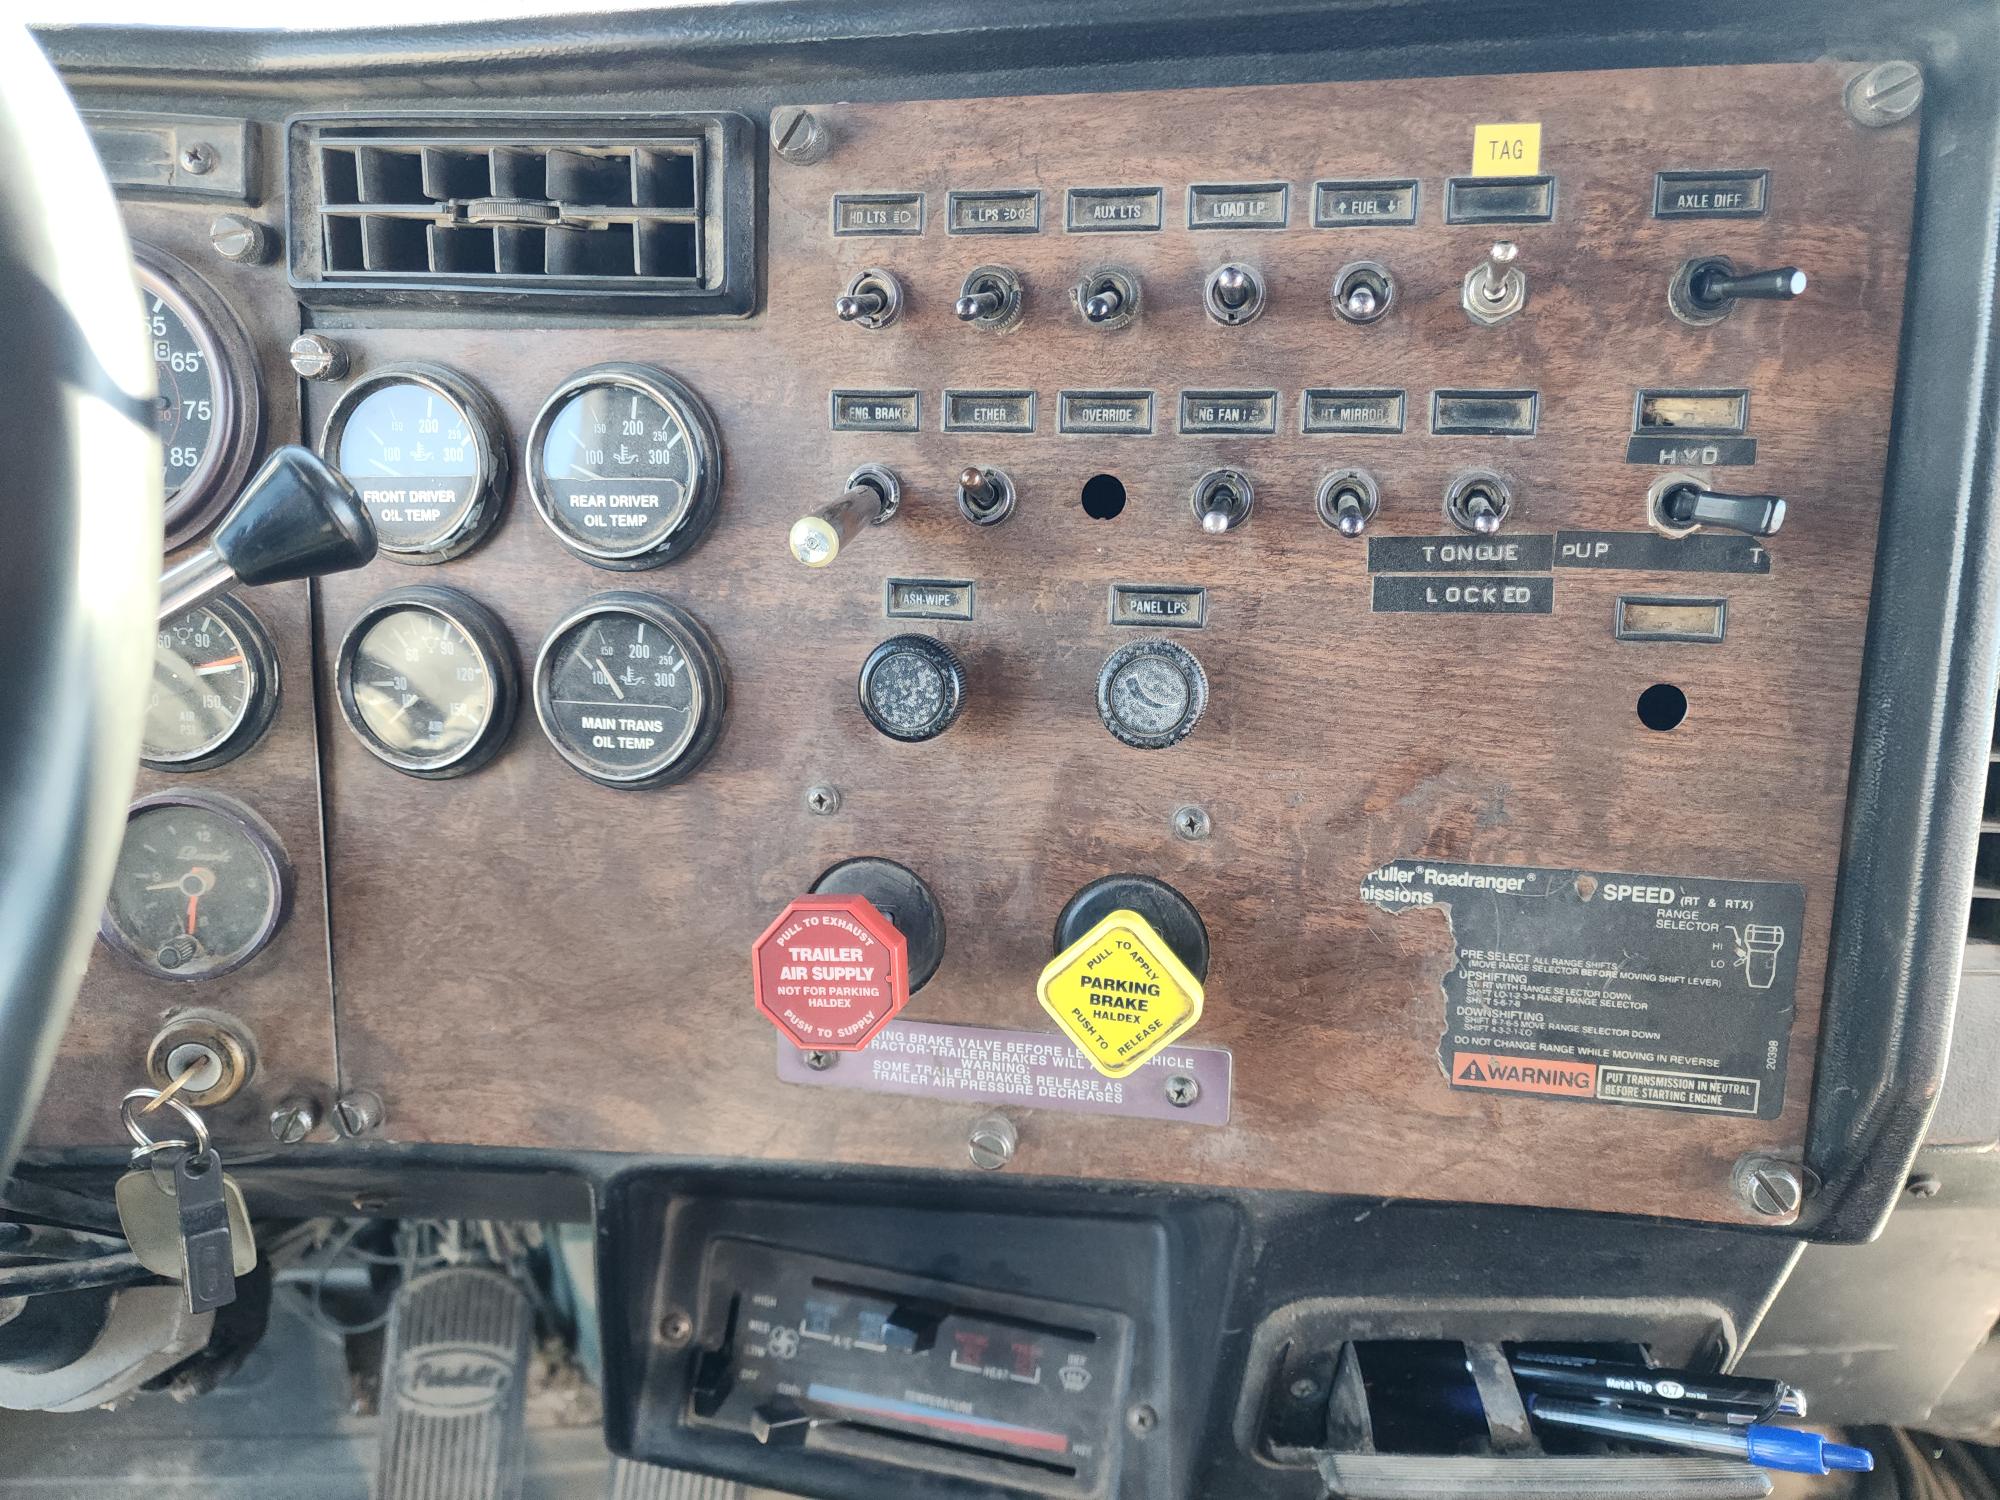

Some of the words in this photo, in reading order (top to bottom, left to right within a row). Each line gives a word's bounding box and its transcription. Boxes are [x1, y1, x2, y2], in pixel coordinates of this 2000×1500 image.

[1489, 140, 1523, 160] TAG
[1351, 201, 1381, 214] FUEL
[1677, 194, 1710, 209] AXLE
[1713, 193, 1743, 208] DIFF
[867, 211, 886, 224] LTS
[978, 208, 999, 222] LPS
[1093, 206, 1116, 220] AUX
[1120, 205, 1141, 219] LTS
[1213, 203, 1245, 218] LOAD
[1249, 202, 1266, 216] LP
[171, 353, 198, 373] 65
[183, 401, 211, 420] 75
[875, 407, 908, 421] BRAKE
[974, 409, 1007, 421] ETHER
[1082, 408, 1132, 422] OVERRIDE
[1218, 408, 1239, 421] FAN
[1340, 408, 1384, 421] MIRROR
[418, 419, 438, 433] 200
[594, 424, 606, 434] 150
[622, 420, 643, 436] 200
[653, 432, 667, 443] 250
[170, 447, 197, 467] 85
[384, 447, 401, 461] 100
[443, 447, 464, 462] 300
[586, 450, 604, 465] 100
[648, 450, 670, 465] 300
[363, 491, 406, 503] FRONT
[409, 491, 456, 503] DRIVER
[570, 494, 607, 507] REAR
[609, 494, 659, 508] DRIVER
[381, 509, 401, 522] OIL
[404, 509, 441, 522] TEMP
[584, 514, 608, 527] OIL
[611, 514, 648, 527] TEMP
[1422, 545, 1519, 562] TONGUE
[1562, 543, 1611, 558] PUP
[1749, 547, 1764, 563] T
[1426, 586, 1531, 603] LOCKED
[1129, 599, 1162, 614] PANEL
[1166, 602, 1188, 614] LPS
[194, 633, 210, 648] 90
[441, 641, 455, 656] 90
[600, 646, 613, 656] 150
[630, 644, 650, 660] 200
[660, 655, 674, 666] 250
[456, 667, 475, 682] 120
[592, 672, 610, 685] 100
[654, 672, 676, 688] 300
[394, 676, 407, 690] 30
[203, 695, 221, 709] 150
[581, 717, 617, 731] MAIN
[618, 719, 664, 733] TRANS
[592, 735, 616, 748] OIL
[618, 737, 655, 750] TEMP
[1603, 883, 1676, 905] SPEED
[1680, 895, 1701, 908] (RT
[1707, 896, 1717, 908] &
[1725, 899, 1754, 912] RTX)
[1656, 909, 1700, 921] RANGE
[777, 924, 804, 947] PULL
[803, 916, 820, 929] TO
[822, 916, 874, 946] EXHAUST
[1655, 919, 1720, 932] SELECTOR
[1712, 942, 1723, 951] HI
[788, 948, 864, 963] TRAILER
[1086, 949, 1113, 970] PULL
[1115, 940, 1132, 951] TO
[1129, 951, 1160, 981] APPLY
[1461, 950, 1531, 964] PRE-SELECT
[1533, 957, 1549, 966] ALL
[1551, 958, 1584, 968] RANGE
[1585, 961, 1618, 971] SHIFTS
[1711, 960, 1725, 969] LO
[780, 966, 809, 980] AIR
[812, 966, 875, 982] SUPPLY
[1459, 971, 1528, 984] UPSHIFTING
[1499, 961, 1530, 972] RANGE
[1532, 964, 1579, 976] SELECTOR
[1581, 968, 1619, 979] BEFORE
[1620, 971, 1657, 982] MOVING
[1659, 974, 1686, 984] SHIFT
[1687, 977, 1722, 988] LEVER)
[777, 986, 801, 996] NOT
[803, 986, 826, 997] FOR
[828, 987, 880, 997] PARKING
[1080, 975, 1161, 998] PARKING
[1495, 983, 1519, 992] WITH
[1520, 985, 1552, 994] RANGE
[1553, 987, 1601, 998] SELECTOR
[1602, 991, 1631, 1001] DOWN
[808, 998, 852, 1008] HALDEX
[1089, 993, 1149, 1012] BRAKE
[1537, 994, 1566, 1004] RAISE
[1568, 996, 1599, 1006] RANGE
[1600, 999, 1649, 1010] SELECTOR
[1093, 1010, 1142, 1025] HALDEX
[1456, 1006, 1545, 1022] DOWNSHIFTING
[784, 1010, 814, 1034] PUSH
[818, 1028, 833, 1038] TO
[838, 1010, 876, 1038] SUPPLY
[1071, 1007, 1097, 1036] PUSH
[1095, 1031, 1109, 1051] TO
[1117, 1018, 1164, 1056] RELEASE
[1464, 1015, 1490, 1025] SHIFT
[1521, 1020, 1546, 1030] MOVE
[1549, 1022, 1581, 1033] RANGE
[1582, 1025, 1630, 1037] SELECTOR
[1631, 1029, 1660, 1040] DOWN
[909, 1033, 954, 1048] BRAKE
[957, 1038, 1002, 1051] VALVE
[1006, 1042, 1063, 1058] BEFORE
[1454, 1034, 1470, 1044] DO
[1471, 1036, 1492, 1046] NOT
[1494, 1039, 1537, 1051] CHANGE
[1539, 1042, 1576, 1054] RANGE
[1577, 1046, 1610, 1058] WHILE
[1612, 1049, 1655, 1062] MOVING
[1656, 1053, 1668, 1063] IN
[1669, 1056, 1721, 1068] REVERSE
[865, 1038, 988, 1061] RACTOR-TRAILER
[992, 1051, 1048, 1067] BRAKES
[1051, 1056, 1085, 1071] WILL
[1766, 1040, 1779, 1071] 20398
[960, 1059, 1031, 1076] WARNING:
[873, 1059, 912, 1074] SOME
[915, 1064, 972, 1080] TRAILER
[976, 1070, 1032, 1086] BRAKES
[1036, 1075, 1100, 1091] RELEASE
[1104, 1081, 1123, 1094] AS
[1487, 1063, 1591, 1089] WARNING
[1605, 1071, 1624, 1084] PUT
[1626, 1073, 1696, 1091] TRANSMISSION
[1697, 1079, 1708, 1091] IN
[1710, 1080, 1752, 1096] NEUTRAL
[872, 1069, 929, 1086] TRAILER
[933, 1076, 956, 1089] AIR
[959, 1080, 1034, 1097] PRESSURE
[1038, 1086, 1124, 1105] DECREASES
[1604, 1084, 1640, 1098] BEFORE
[1641, 1087, 1687, 1102] STARTING
[1689, 1092, 1723, 1105] ENGINE
[1605, 1377, 1635, 1391] Metal
[1636, 1380, 1653, 1395] Tip
[1661, 1383, 1679, 1397] 0.7
